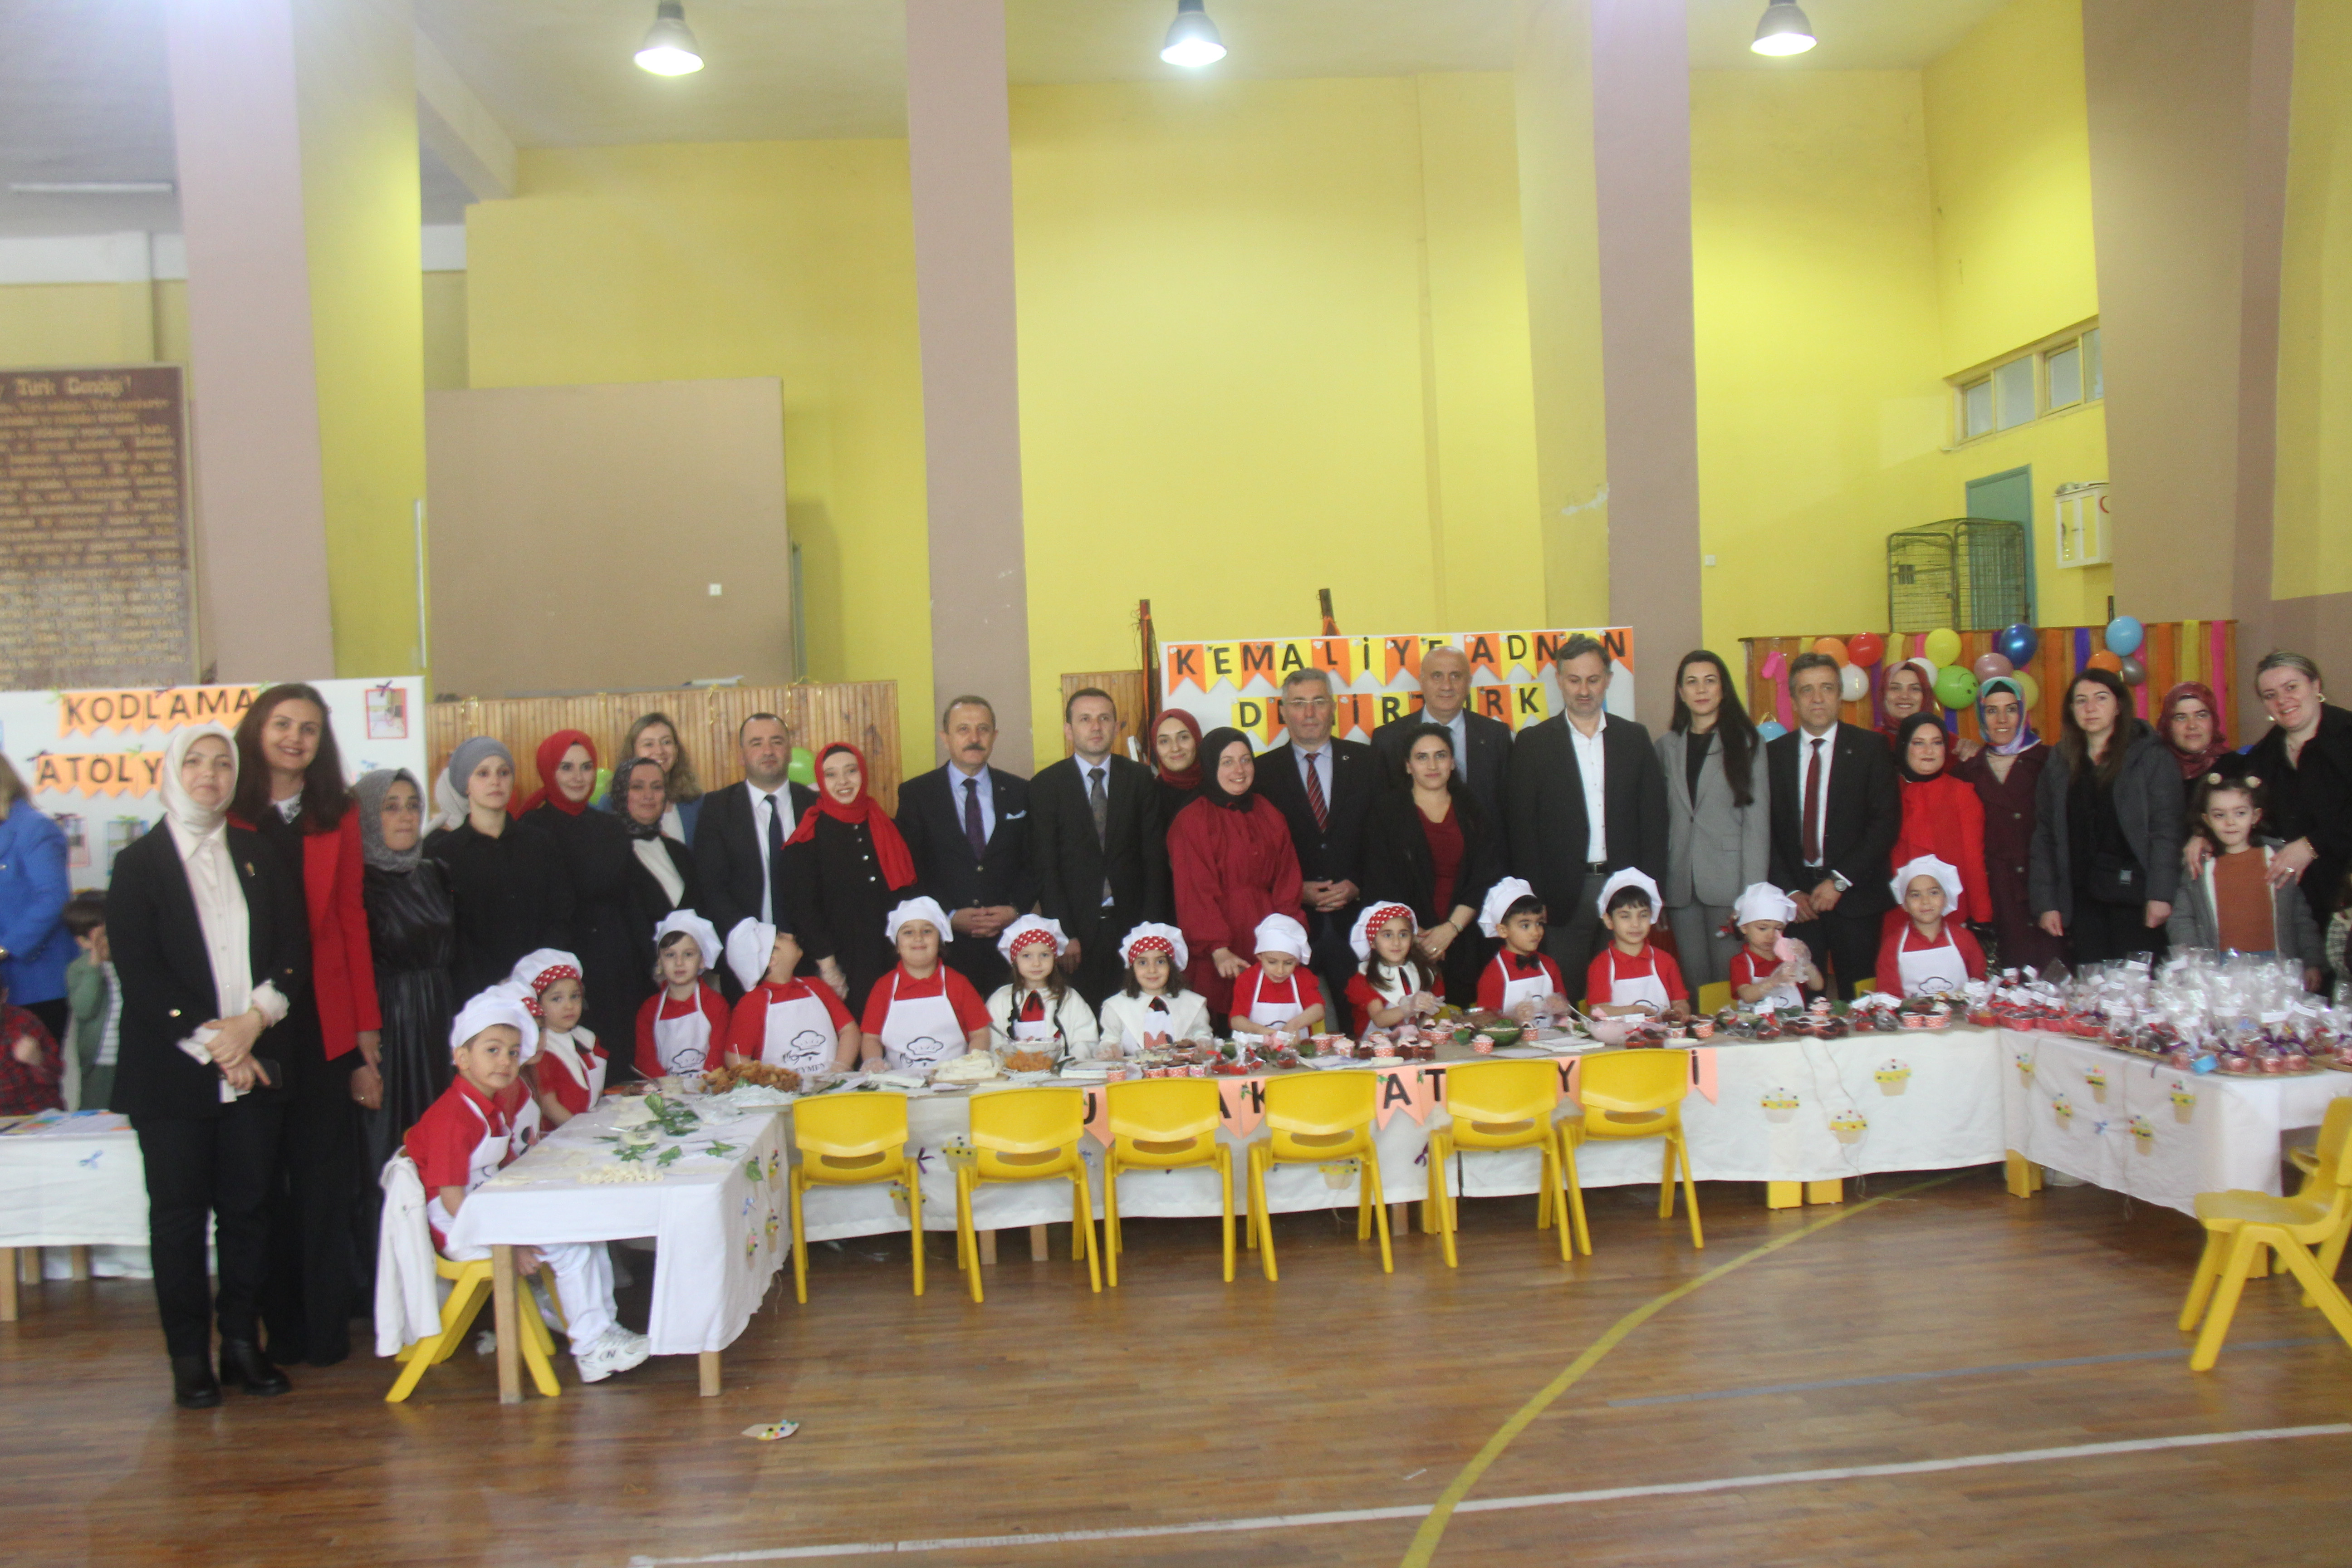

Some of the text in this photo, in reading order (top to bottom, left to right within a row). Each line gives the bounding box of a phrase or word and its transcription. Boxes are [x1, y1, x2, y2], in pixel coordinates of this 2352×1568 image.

[1471, 631, 1625, 663] ADNN
[66, 689, 255, 726] KODLAMA
[1240, 687, 1540, 727] DİRRK
